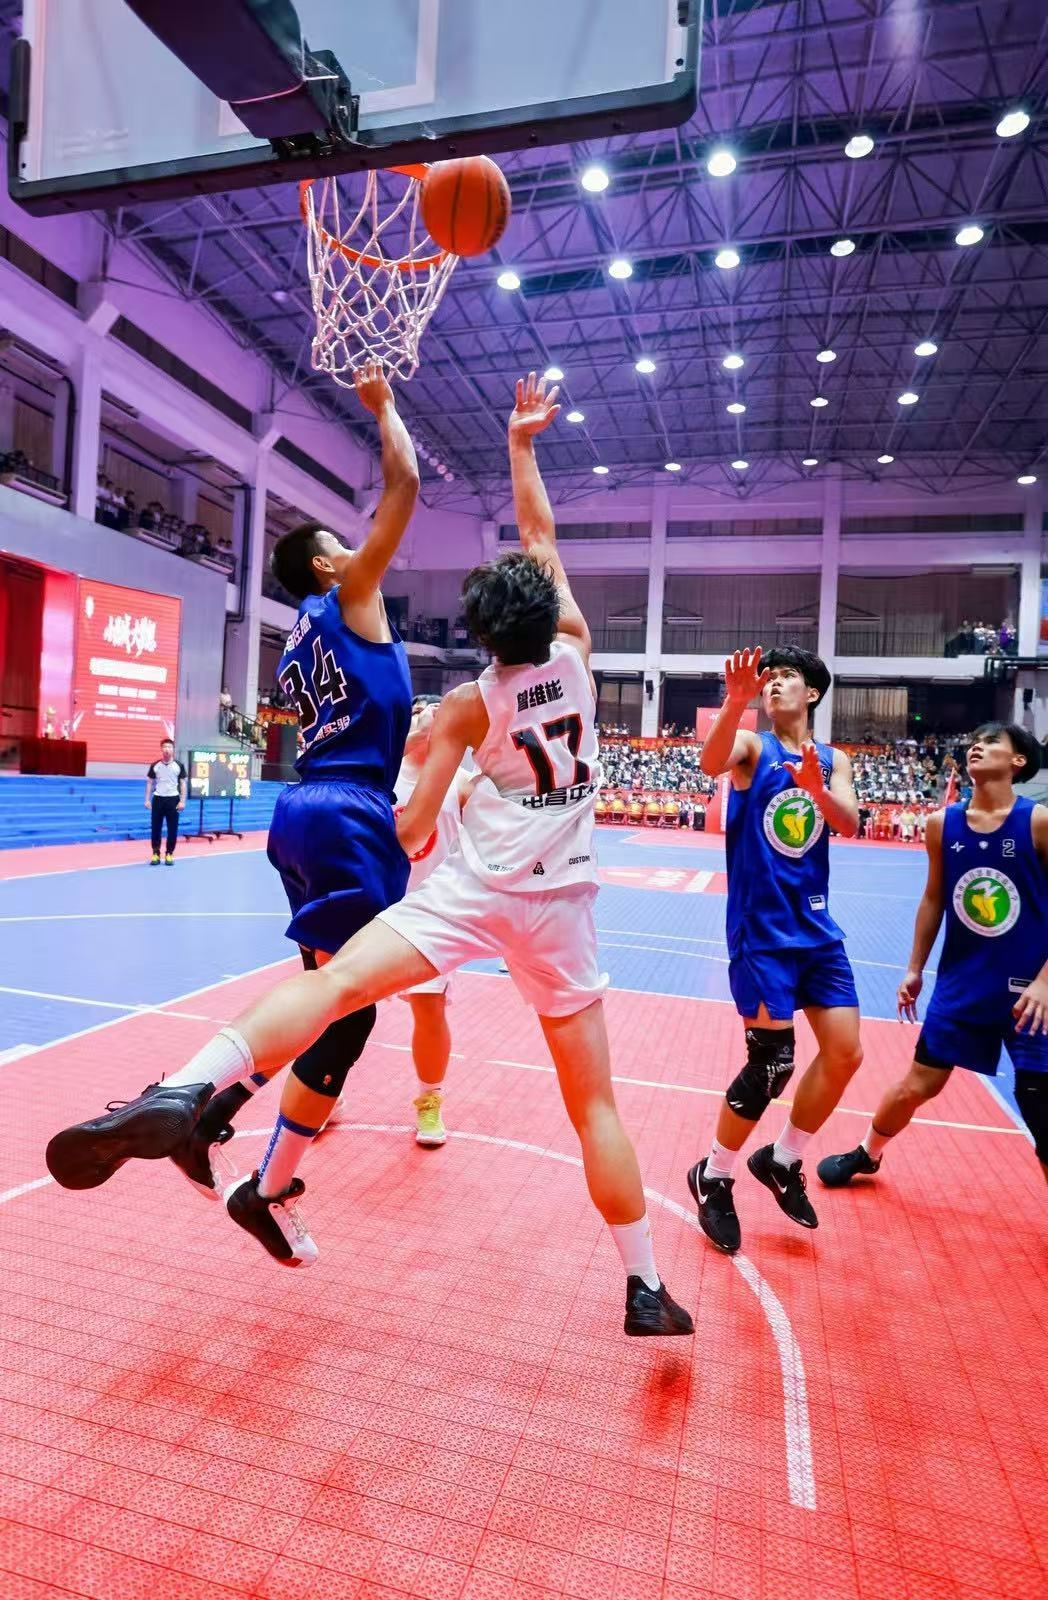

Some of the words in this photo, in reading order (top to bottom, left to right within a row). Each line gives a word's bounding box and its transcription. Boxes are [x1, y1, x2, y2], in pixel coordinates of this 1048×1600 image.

[278, 635, 348, 734] 34
[509, 713, 591, 796] 17
[568, 855, 591, 865] CUSTOM
[1001, 838, 1016, 858] 2
